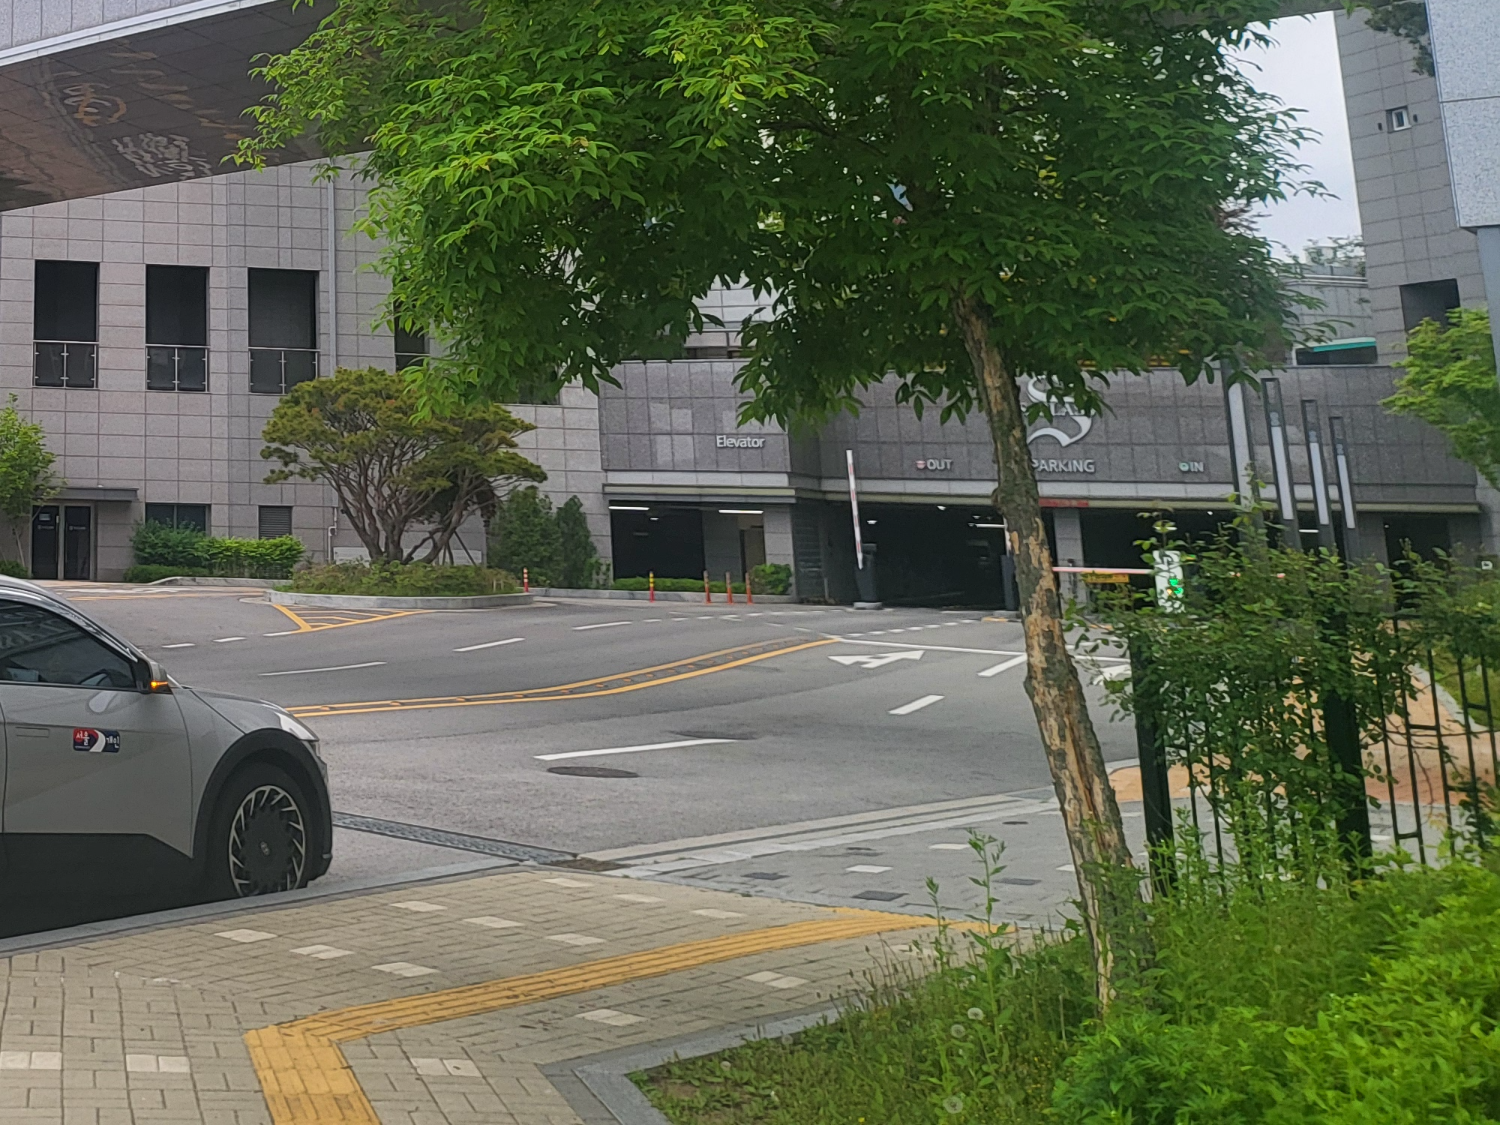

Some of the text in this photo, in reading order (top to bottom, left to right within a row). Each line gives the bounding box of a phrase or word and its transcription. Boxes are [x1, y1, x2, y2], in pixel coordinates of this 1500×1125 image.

[716, 435, 766, 448] Elevator
[927, 459, 952, 470] OUT
[1189, 461, 1204, 472] IN
